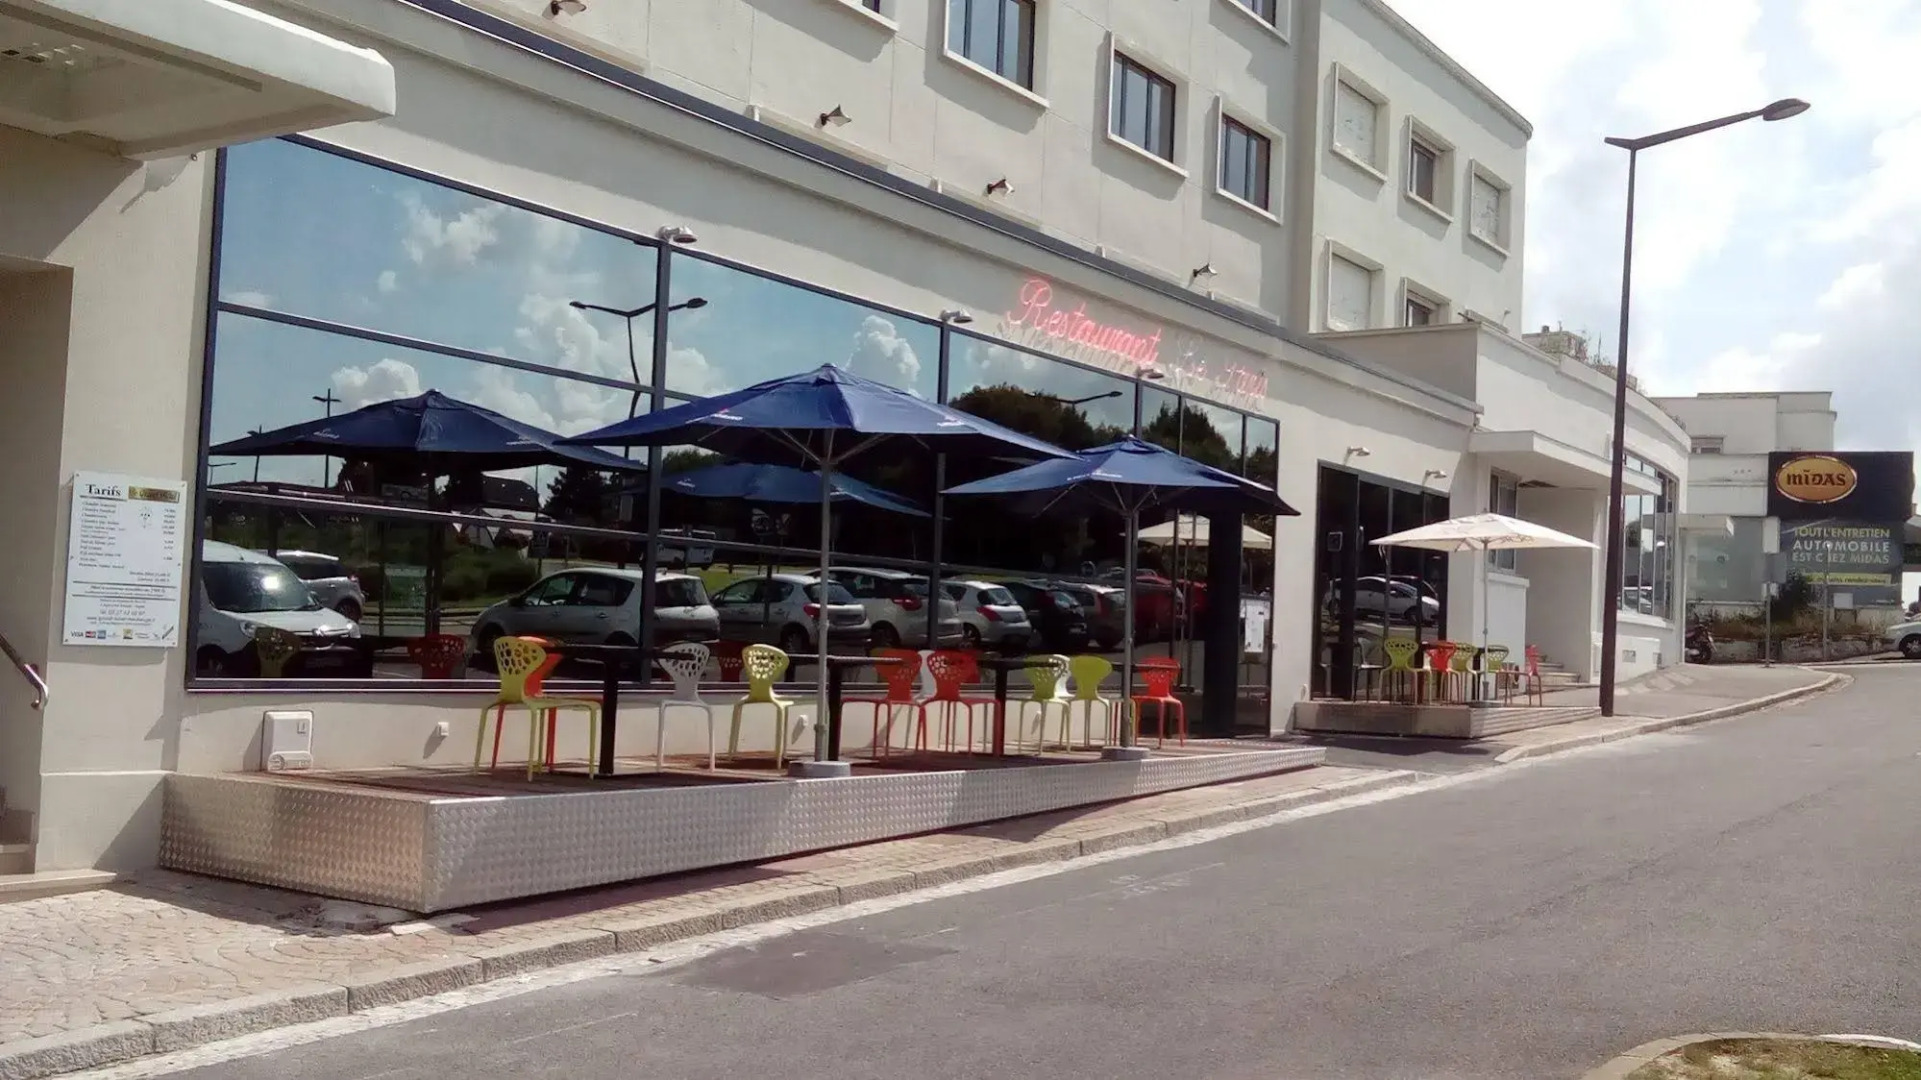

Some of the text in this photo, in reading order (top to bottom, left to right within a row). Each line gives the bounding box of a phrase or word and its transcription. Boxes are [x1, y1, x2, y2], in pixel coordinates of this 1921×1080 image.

[1006, 278, 1162, 365] Restaurant
[85, 483, 122, 497] Tarifs
[1794, 527, 1890, 539] TOUT L'ENTRETIEN
[1792, 540, 1890, 552] AUTOMOBILE
[1792, 552, 1812, 563] EST
[1849, 553, 1890, 564] MIDAS
